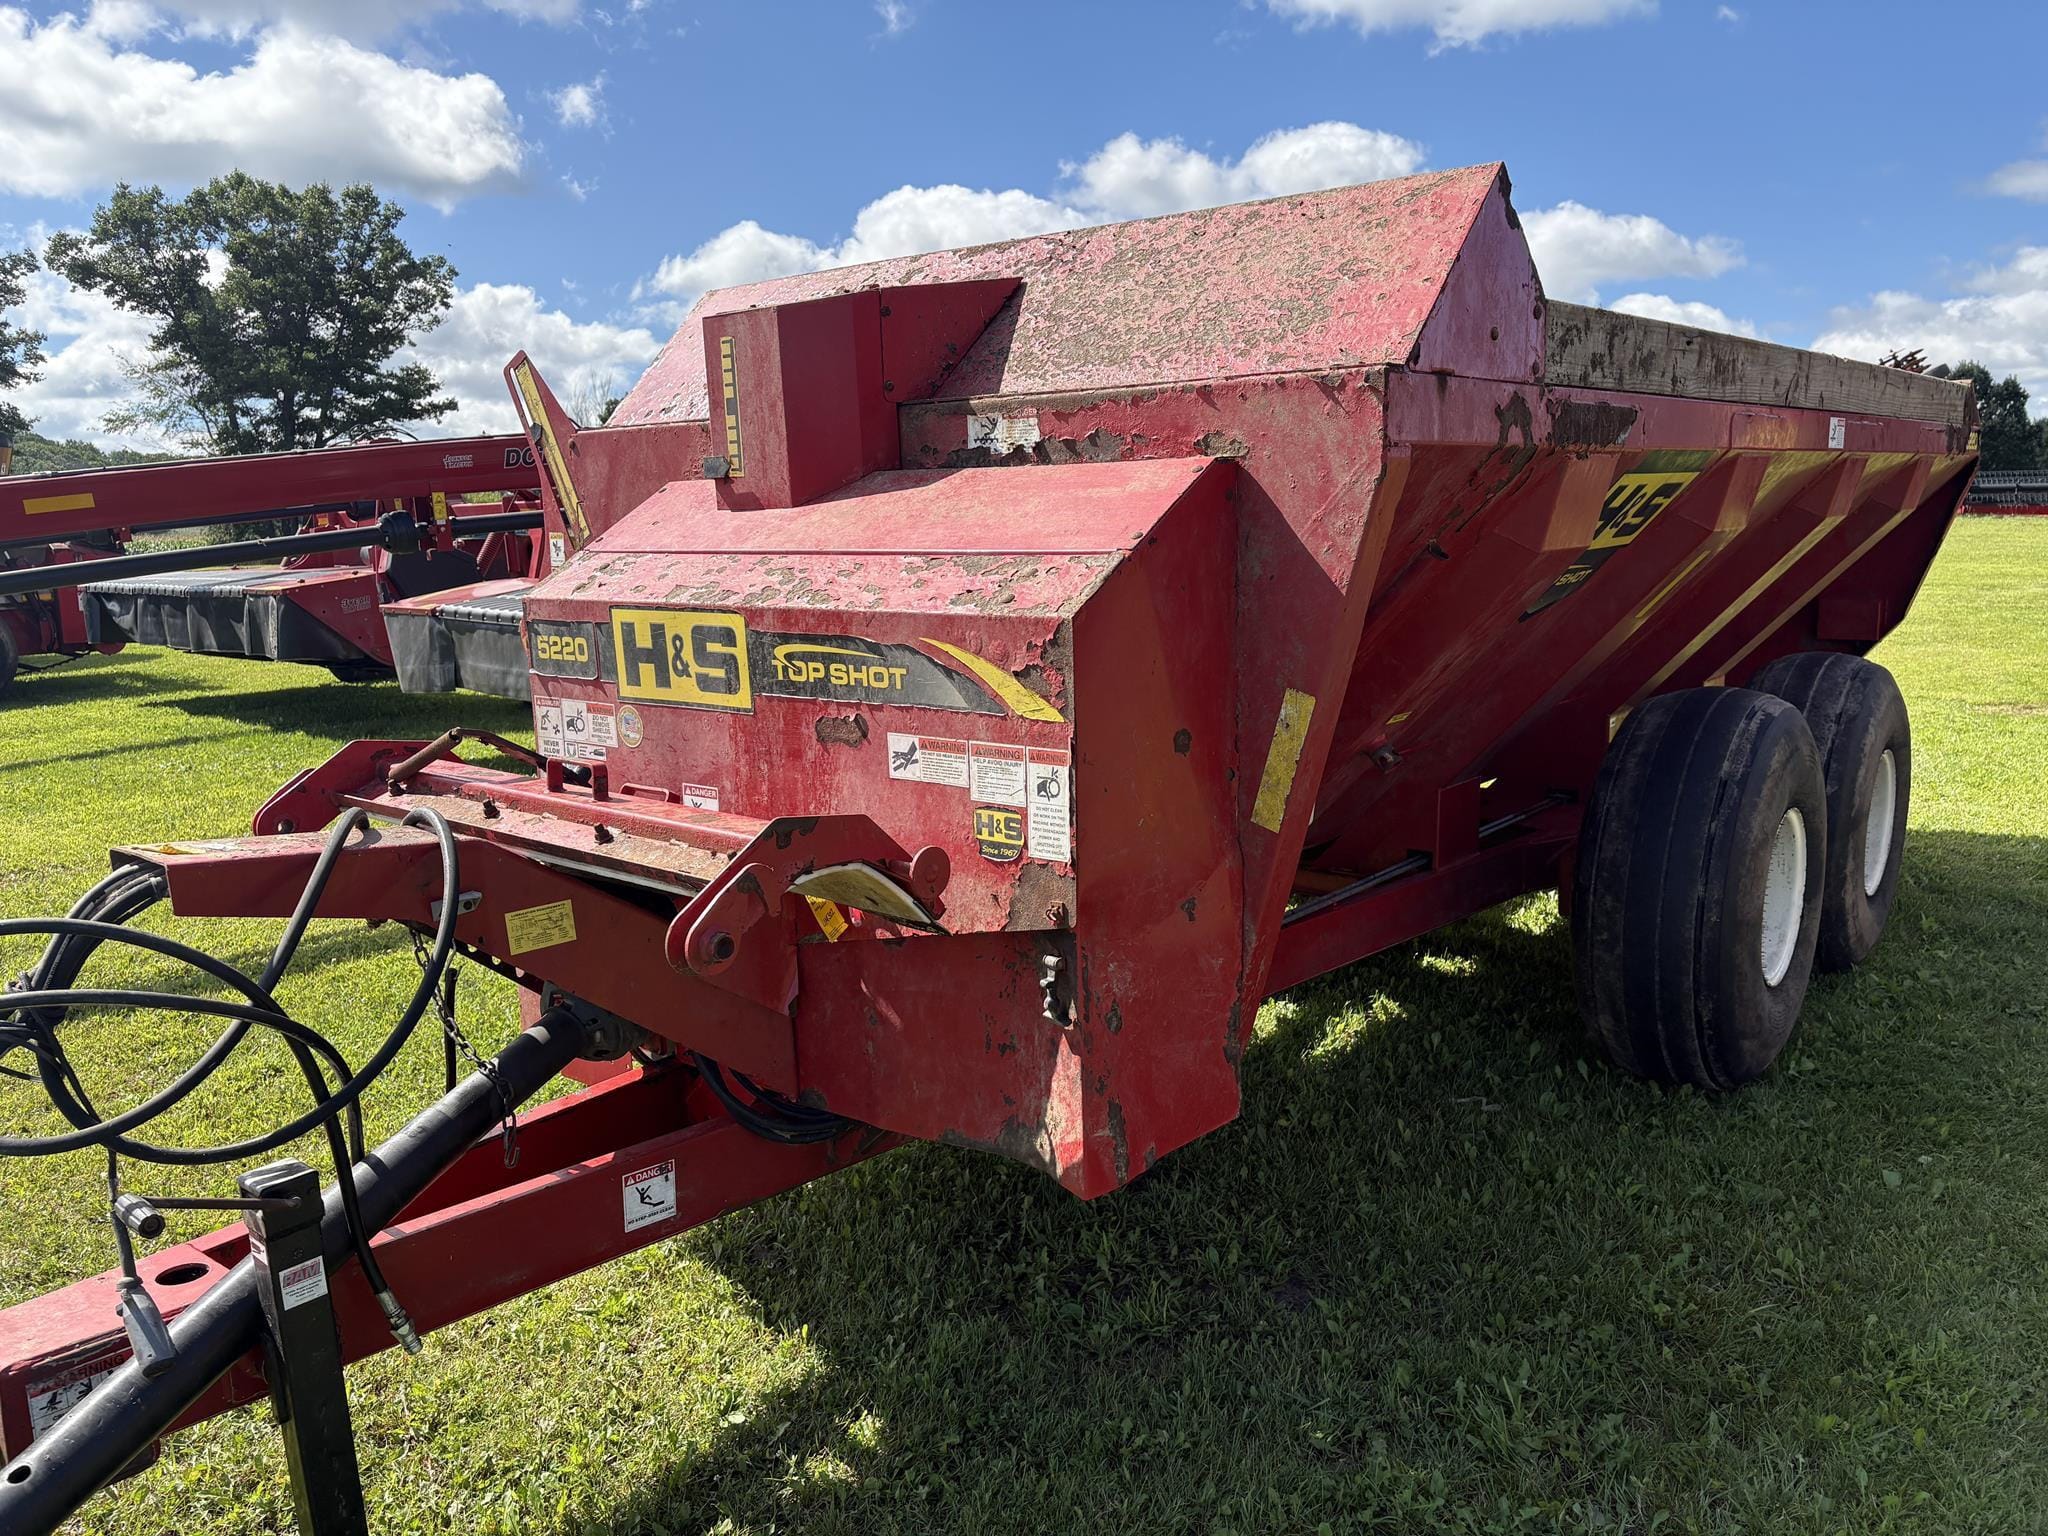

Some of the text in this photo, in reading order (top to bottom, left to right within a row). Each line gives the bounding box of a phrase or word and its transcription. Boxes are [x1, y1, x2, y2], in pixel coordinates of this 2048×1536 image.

[1593, 482, 1684, 538] H&S
[1555, 569, 1592, 586] SHOT
[537, 635, 589, 663] 5220
[620, 621, 741, 695] H&S
[771, 659, 907, 689] TOP SHOT
[928, 740, 966, 753] WARNING
[981, 748, 1020, 760] WARNING
[1036, 752, 1067, 764] WARNING
[691, 787, 717, 798] DANGER
[975, 812, 1022, 841] H&S
[982, 845, 1018, 857] Since 1967
[635, 1163, 672, 1182] DANGER
